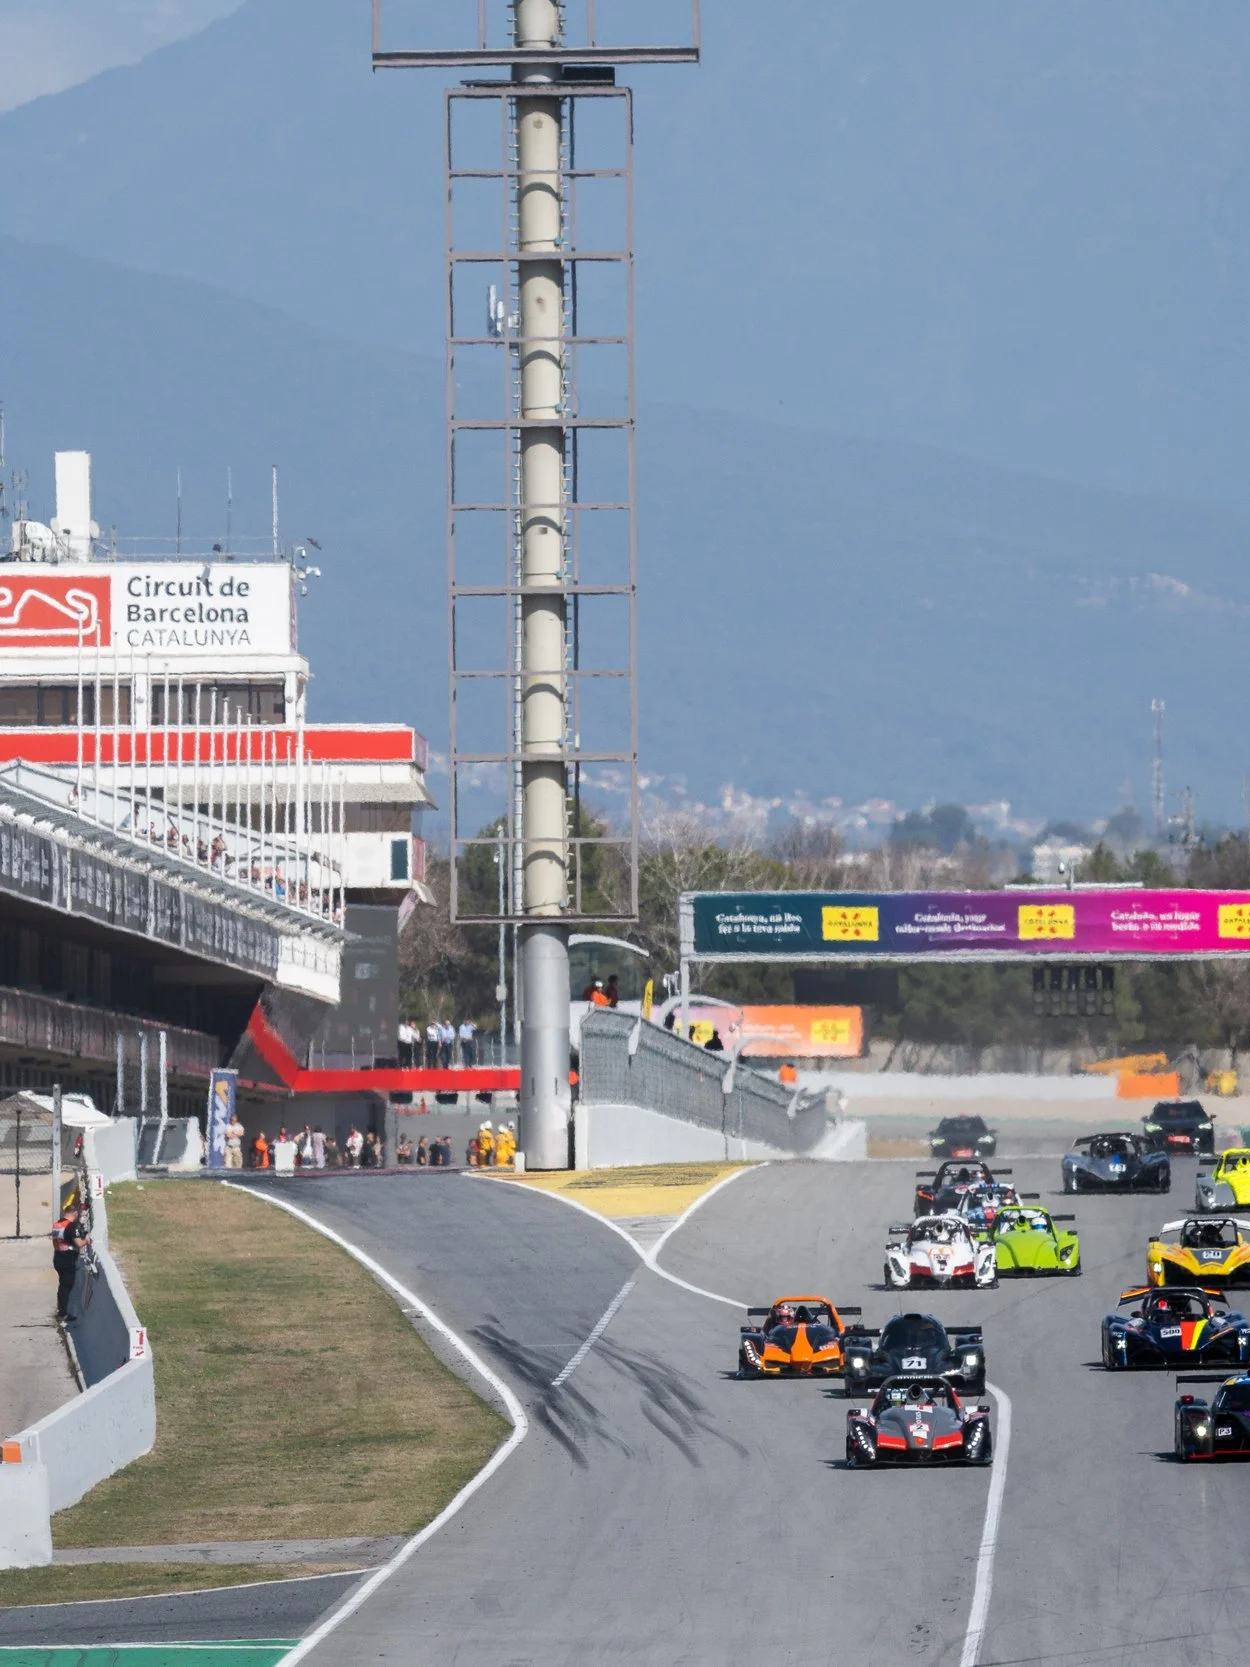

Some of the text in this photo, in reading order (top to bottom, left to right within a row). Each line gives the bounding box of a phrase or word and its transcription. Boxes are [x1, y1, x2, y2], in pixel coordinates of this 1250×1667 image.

[127, 575, 250, 597] Circuit de
[127, 602, 249, 623] Barcelona
[127, 629, 251, 647] CATALUNYA
